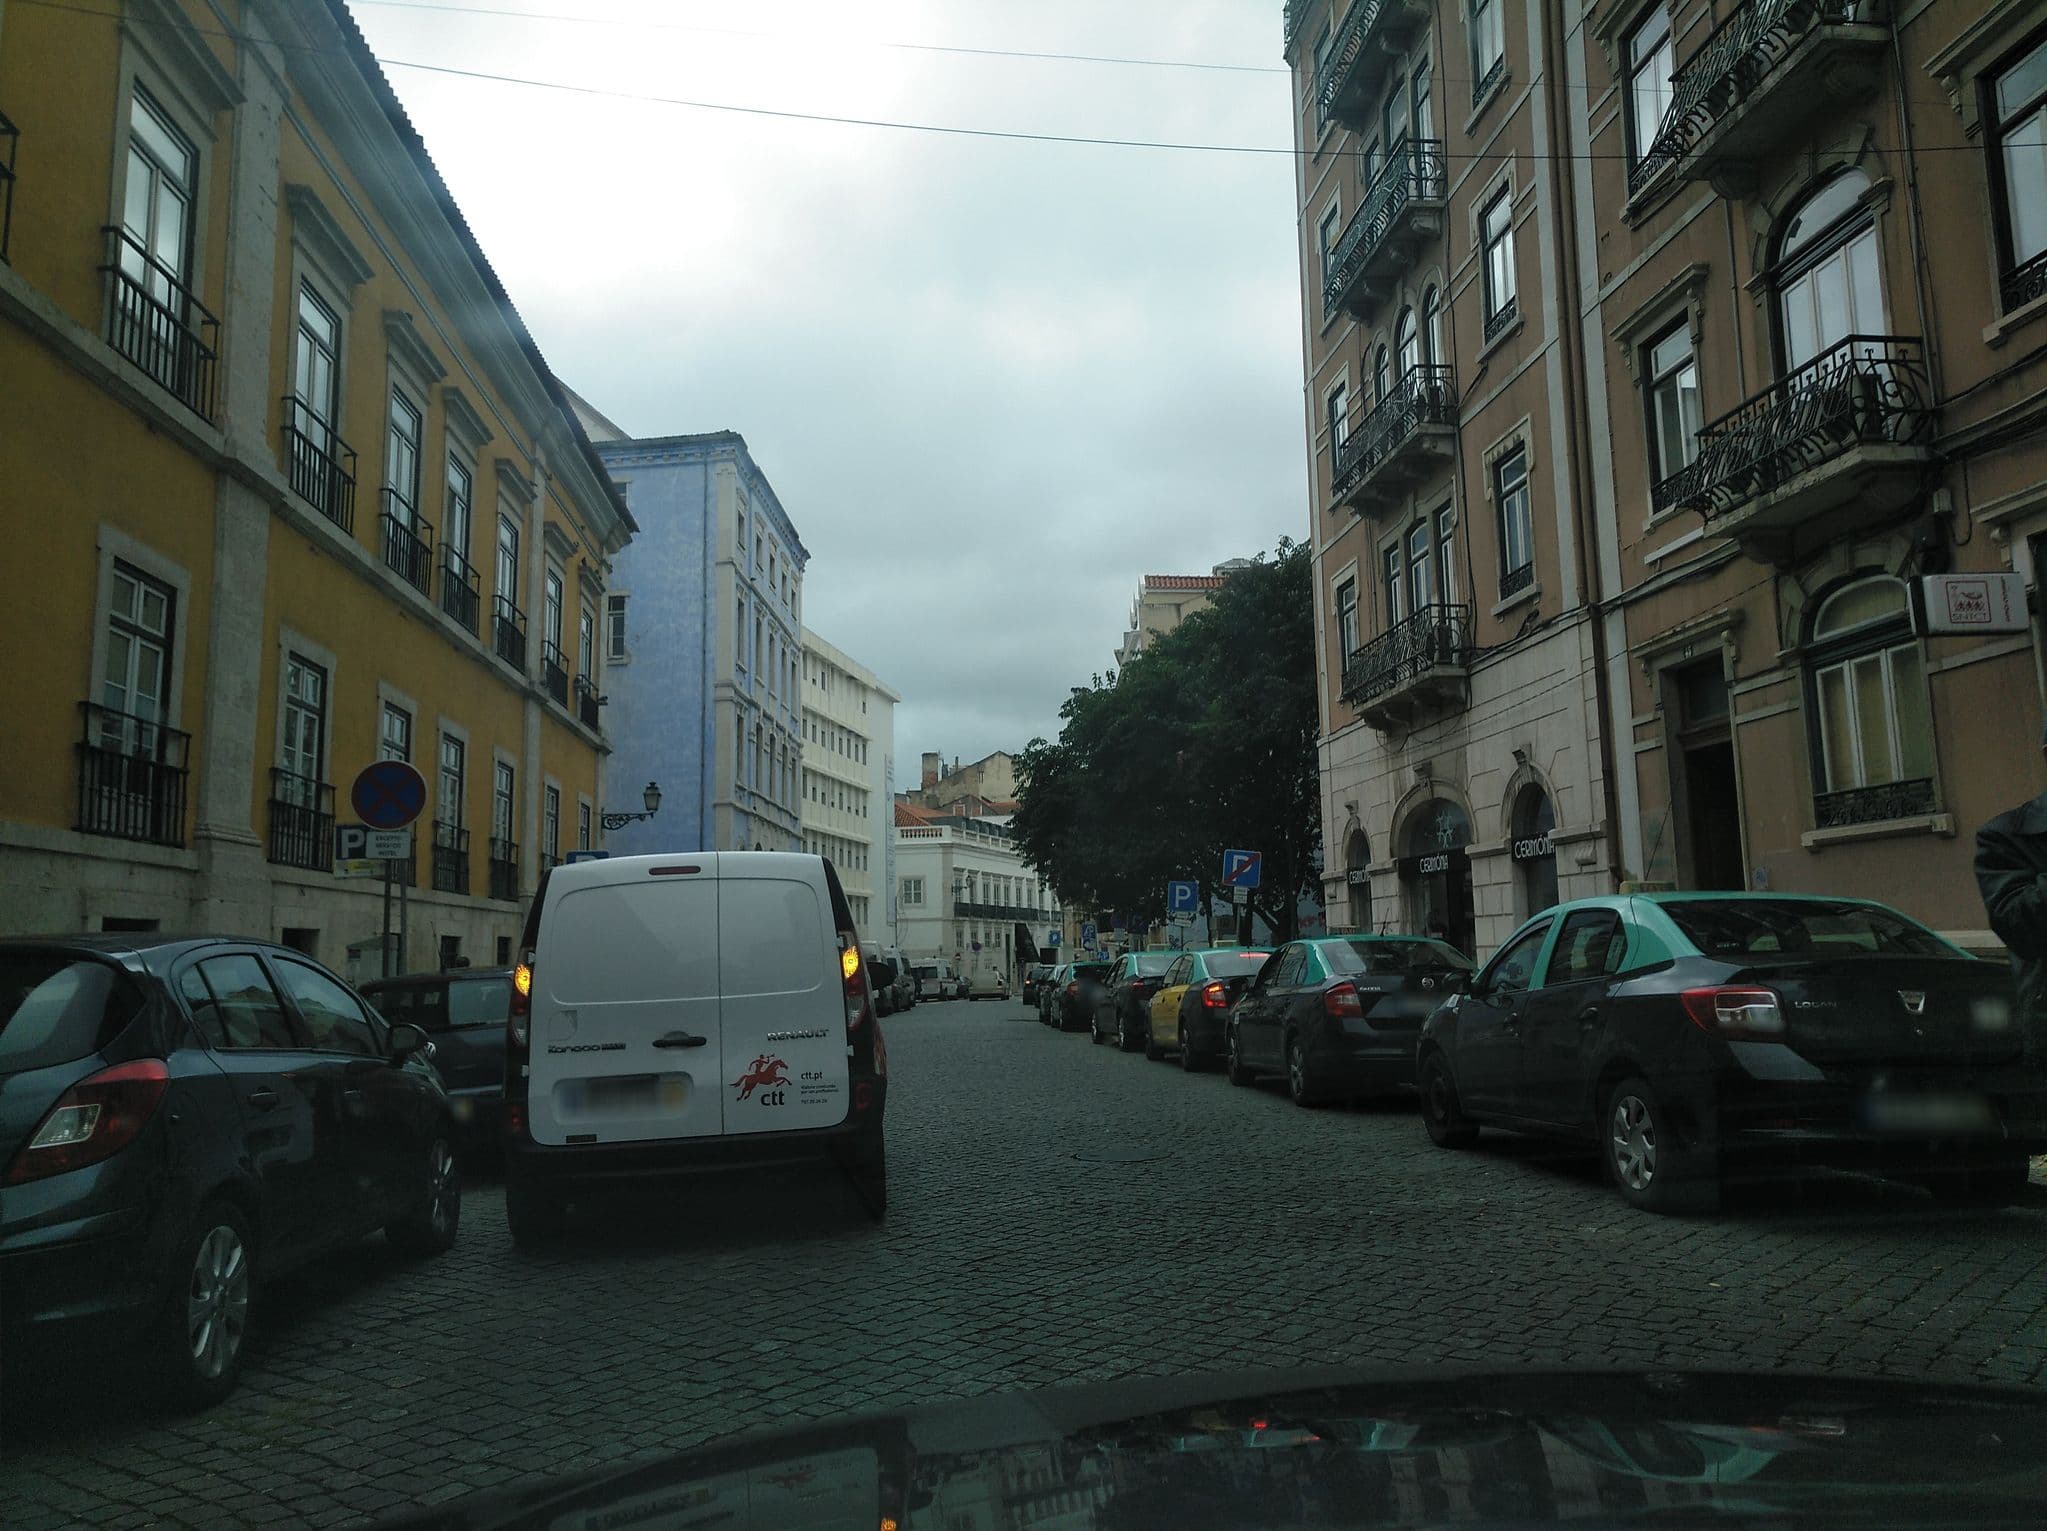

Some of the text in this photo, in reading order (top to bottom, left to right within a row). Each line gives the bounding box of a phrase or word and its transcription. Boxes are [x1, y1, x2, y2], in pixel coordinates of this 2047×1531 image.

[341, 829, 365, 858] P
[1175, 885, 1191, 907] P
[767, 1029, 829, 1041] RENAULT
[800, 1071, 823, 1081] ctt.pt
[761, 1091, 785, 1106] ctt
